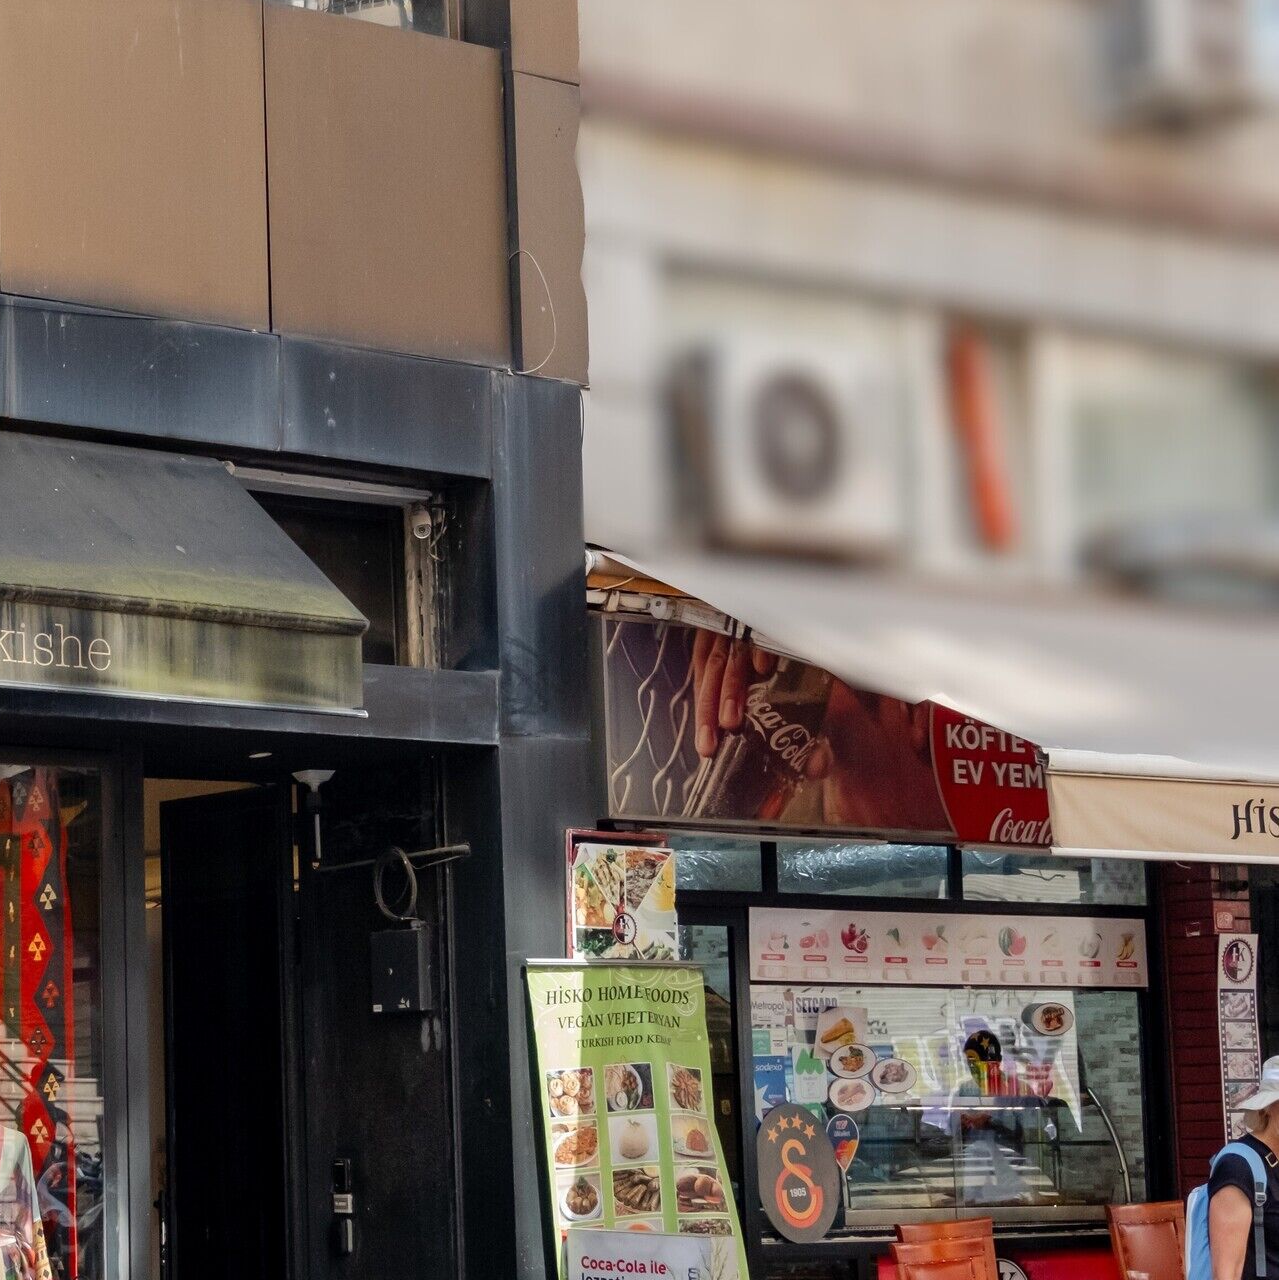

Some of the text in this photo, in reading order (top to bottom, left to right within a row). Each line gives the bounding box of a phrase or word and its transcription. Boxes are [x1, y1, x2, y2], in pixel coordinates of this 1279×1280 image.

[945, 719, 1027, 753] KÖFTE
[953, 759, 984, 786] EV
[546, 985, 690, 1006] HİSKO HOME FOODS
[558, 1011, 681, 1029] VEGAN VEJETERYAN
[575, 1035, 614, 1049] TURKISH
[616, 1034, 643, 1046] FOOD
[755, 1063, 783, 1071] sodexo
[789, 1187, 806, 1197] 1905
[581, 1255, 667, 1274] Coca-Cola ile
